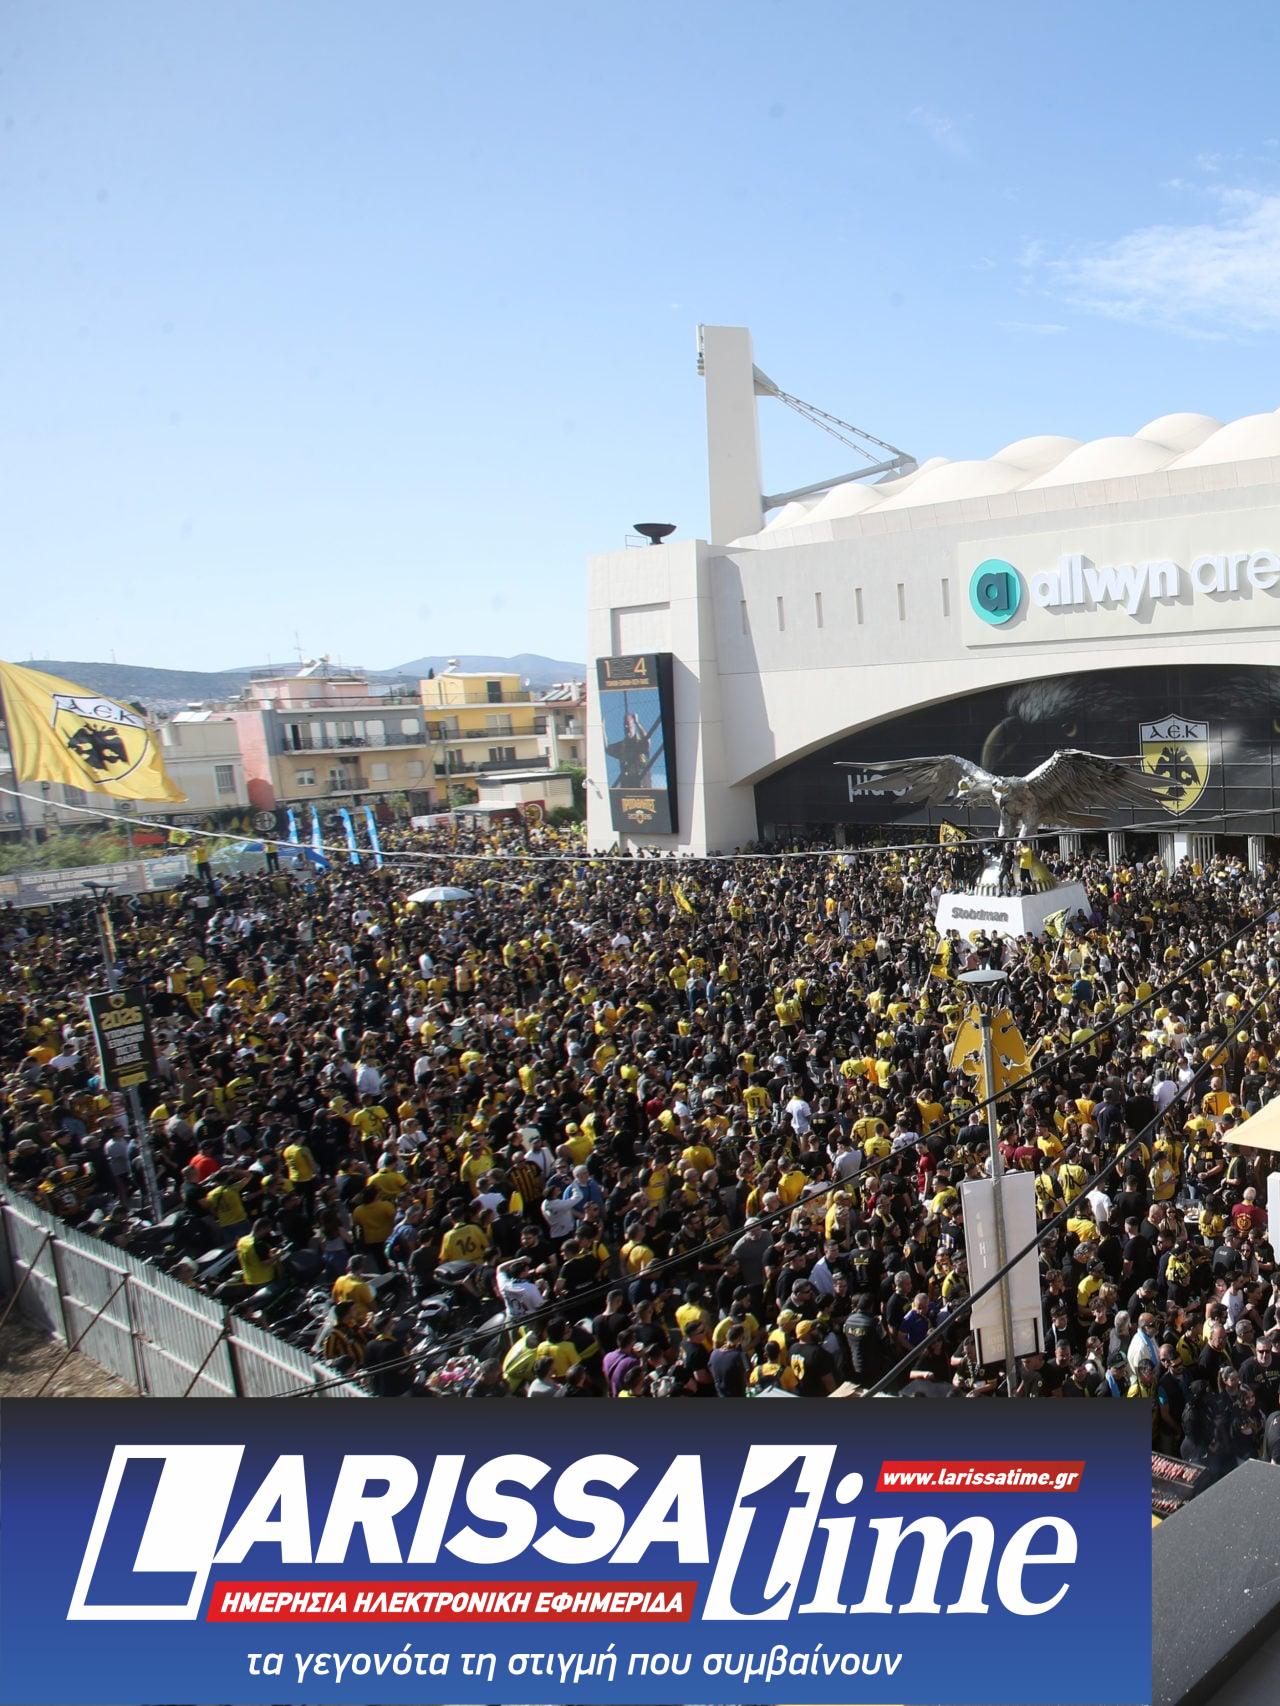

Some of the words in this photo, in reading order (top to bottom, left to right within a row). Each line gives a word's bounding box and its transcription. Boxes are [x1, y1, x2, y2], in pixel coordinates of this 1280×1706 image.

[1031, 554, 1180, 615] allwyn
[100, 1006, 143, 1031] 2026
[455, 1236, 477, 1253] 16
